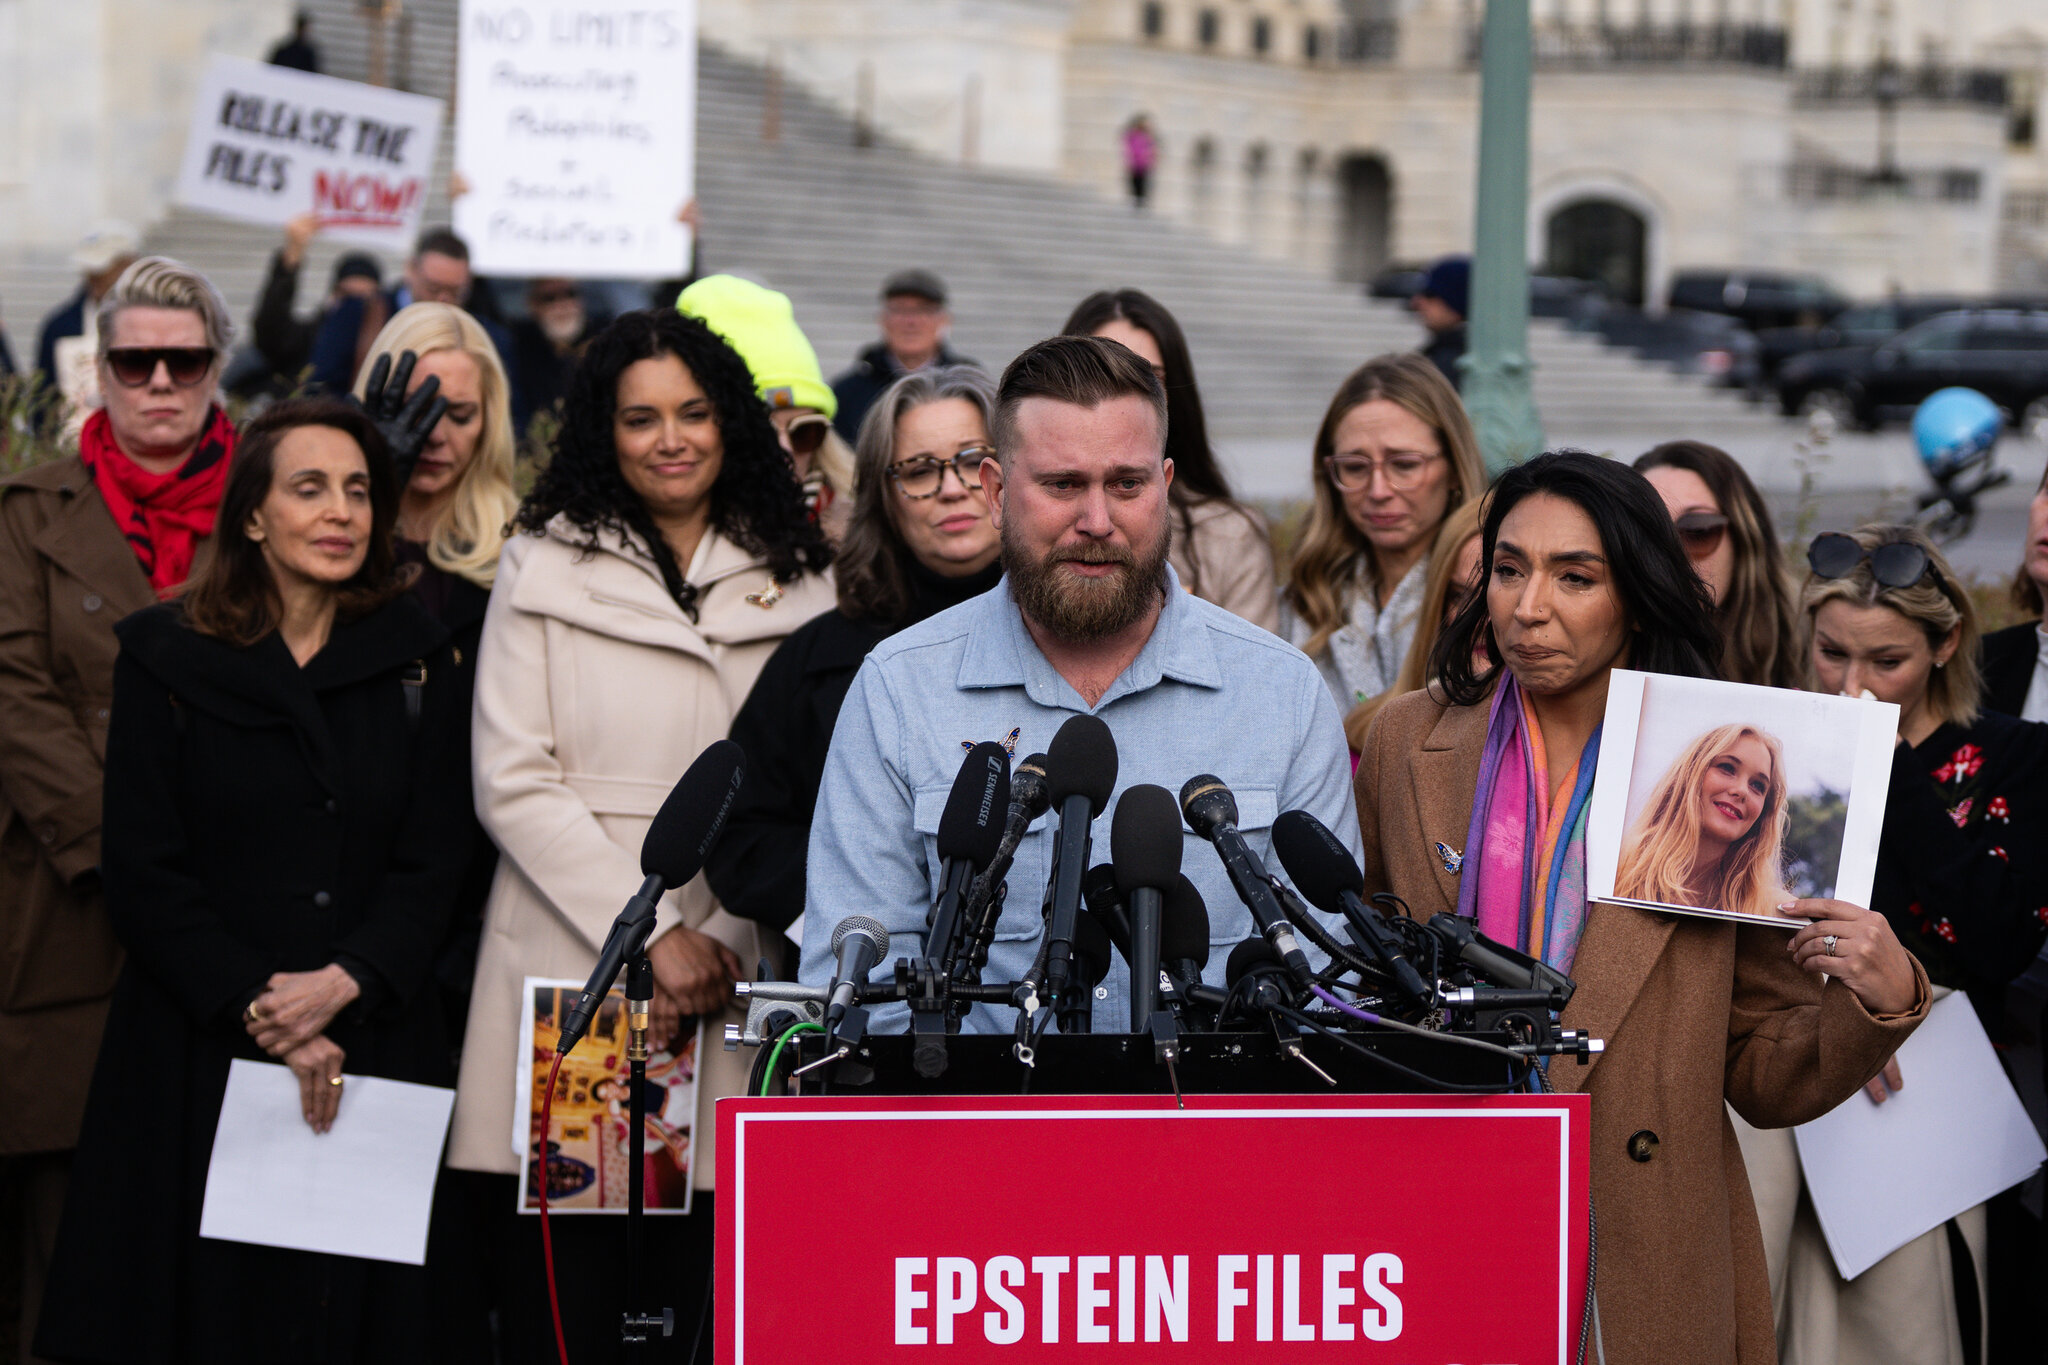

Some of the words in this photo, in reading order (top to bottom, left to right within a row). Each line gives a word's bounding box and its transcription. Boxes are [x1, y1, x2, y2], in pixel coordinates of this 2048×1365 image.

[472, 7, 532, 49] NO
[549, 9, 682, 51] LIMITS
[218, 89, 346, 150] RELEASE
[354, 117, 413, 164] THE
[204, 142, 290, 192] FILES
[313, 168, 422, 212] NOW!
[698, 788, 735, 856] SENNHEISER
[977, 773, 998, 827] SENNHEISER
[895, 1255, 1189, 1345] EPSTEIN
[1218, 1253, 1404, 1342] FILES
